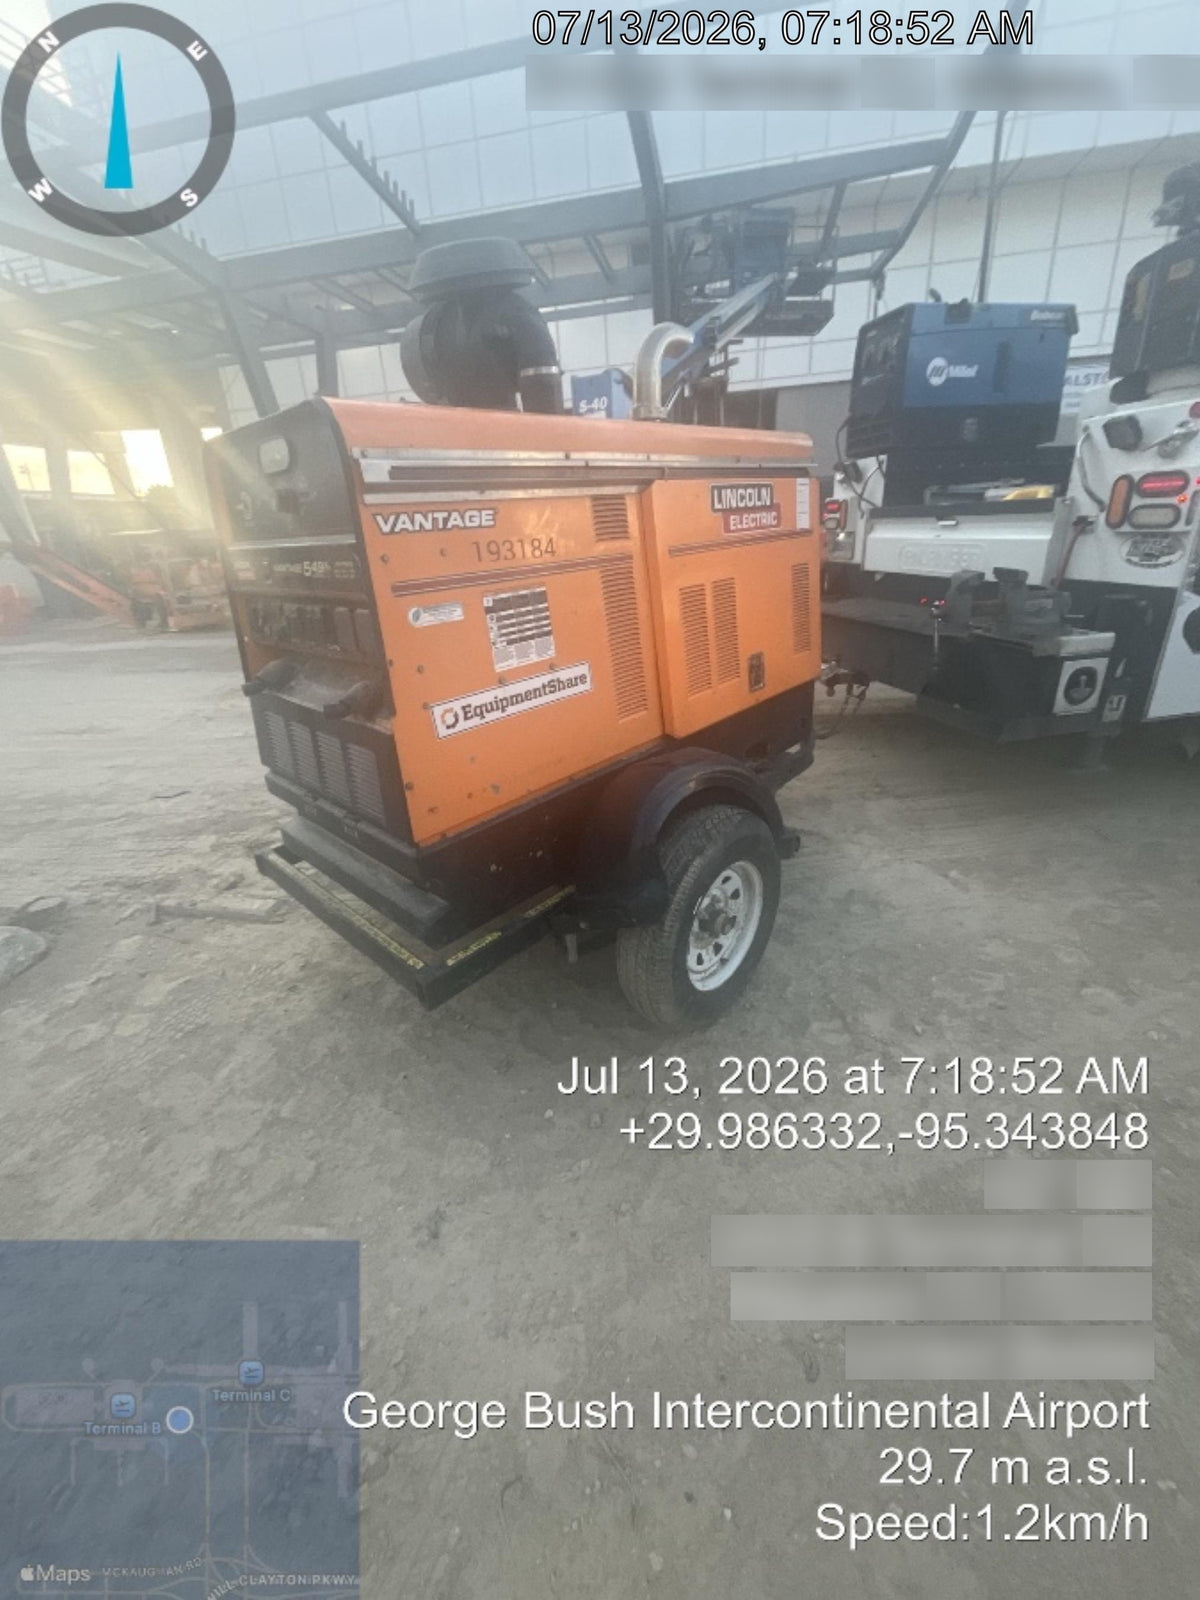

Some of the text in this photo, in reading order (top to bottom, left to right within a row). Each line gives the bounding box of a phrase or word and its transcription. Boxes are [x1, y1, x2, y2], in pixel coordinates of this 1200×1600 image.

[580, 396, 608, 413] S-40
[714, 486, 771, 509] LINCOLN
[374, 508, 497, 534] VANTAGE
[730, 511, 778, 530] ELECTRIC
[472, 537, 557, 562] 193184
[461, 673, 588, 721] EquipmentShare
